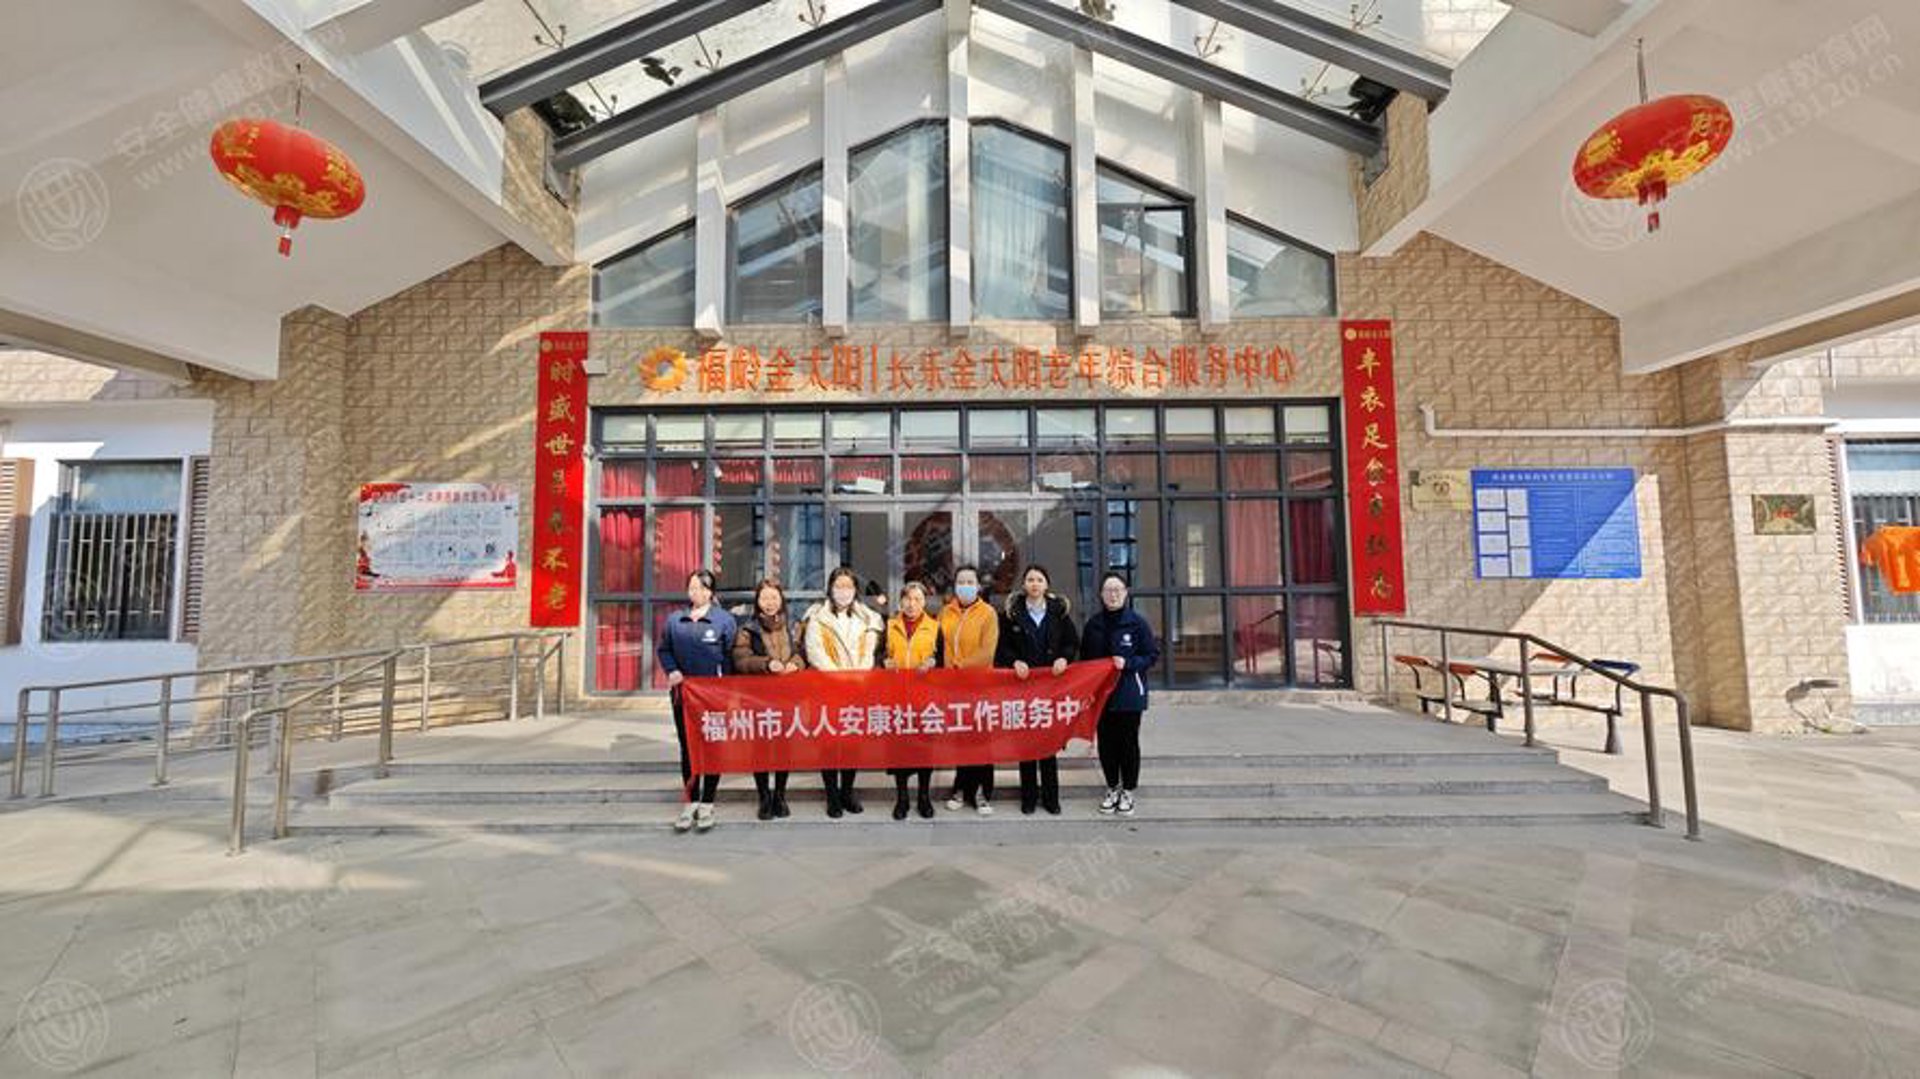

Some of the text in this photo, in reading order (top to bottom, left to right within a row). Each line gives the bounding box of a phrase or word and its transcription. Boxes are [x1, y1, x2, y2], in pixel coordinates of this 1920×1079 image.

[699, 344, 1296, 392] 福龄金太阳 长乐金太阳老年综合服务中心
[701, 695, 1097, 742] 福州市人人安康社会工作服务中
